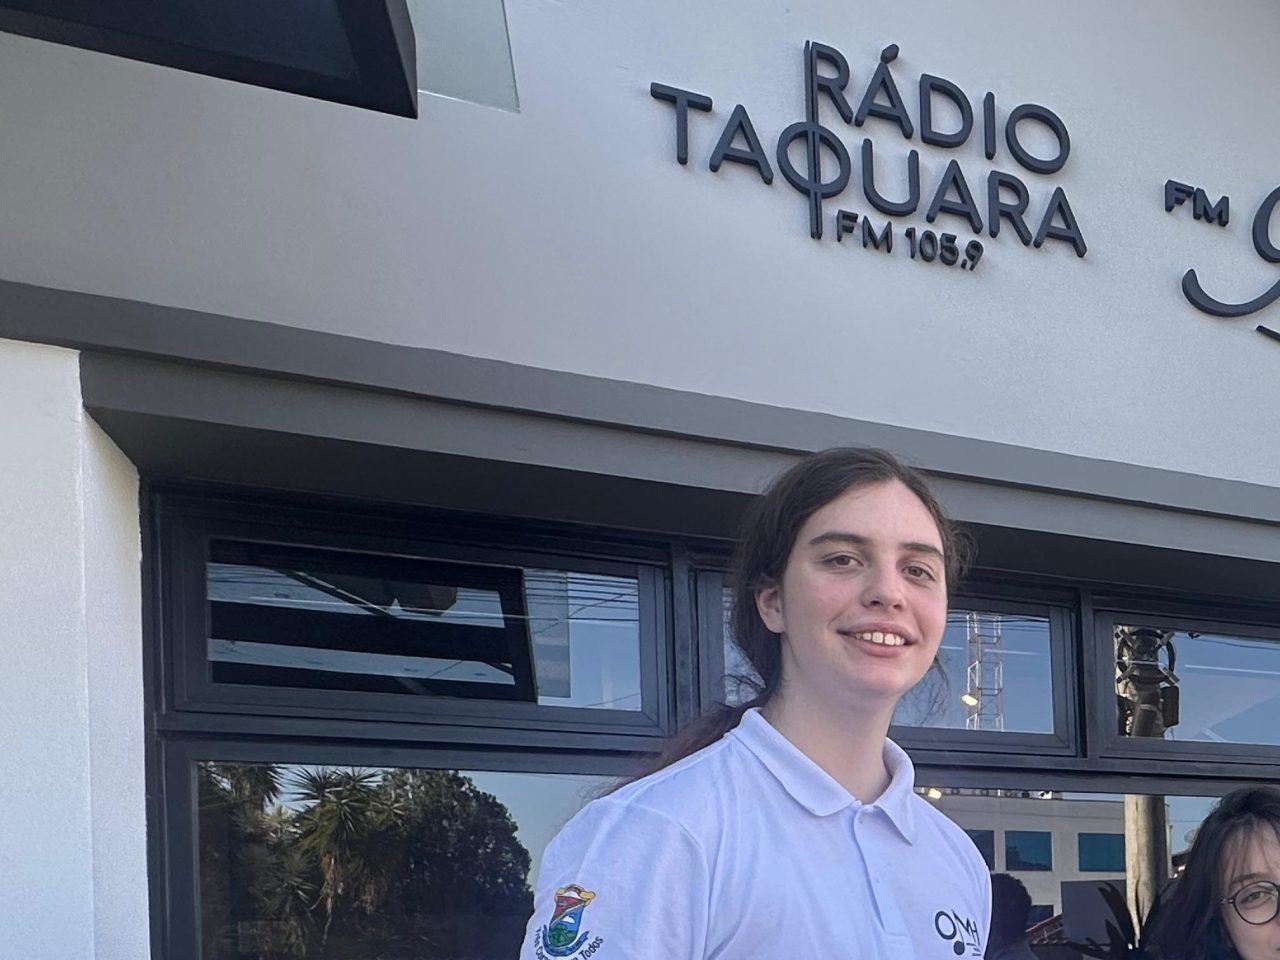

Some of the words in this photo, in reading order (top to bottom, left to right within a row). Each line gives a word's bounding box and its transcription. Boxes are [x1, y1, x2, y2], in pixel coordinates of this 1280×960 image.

[804, 40, 1071, 175] RÁDIO
[650, 82, 1088, 258] TAQUARA
[1164, 179, 1230, 227] FM
[836, 209, 893, 254] FM
[904, 227, 984, 271] 105.9
[580, 936, 604, 960] Todos
